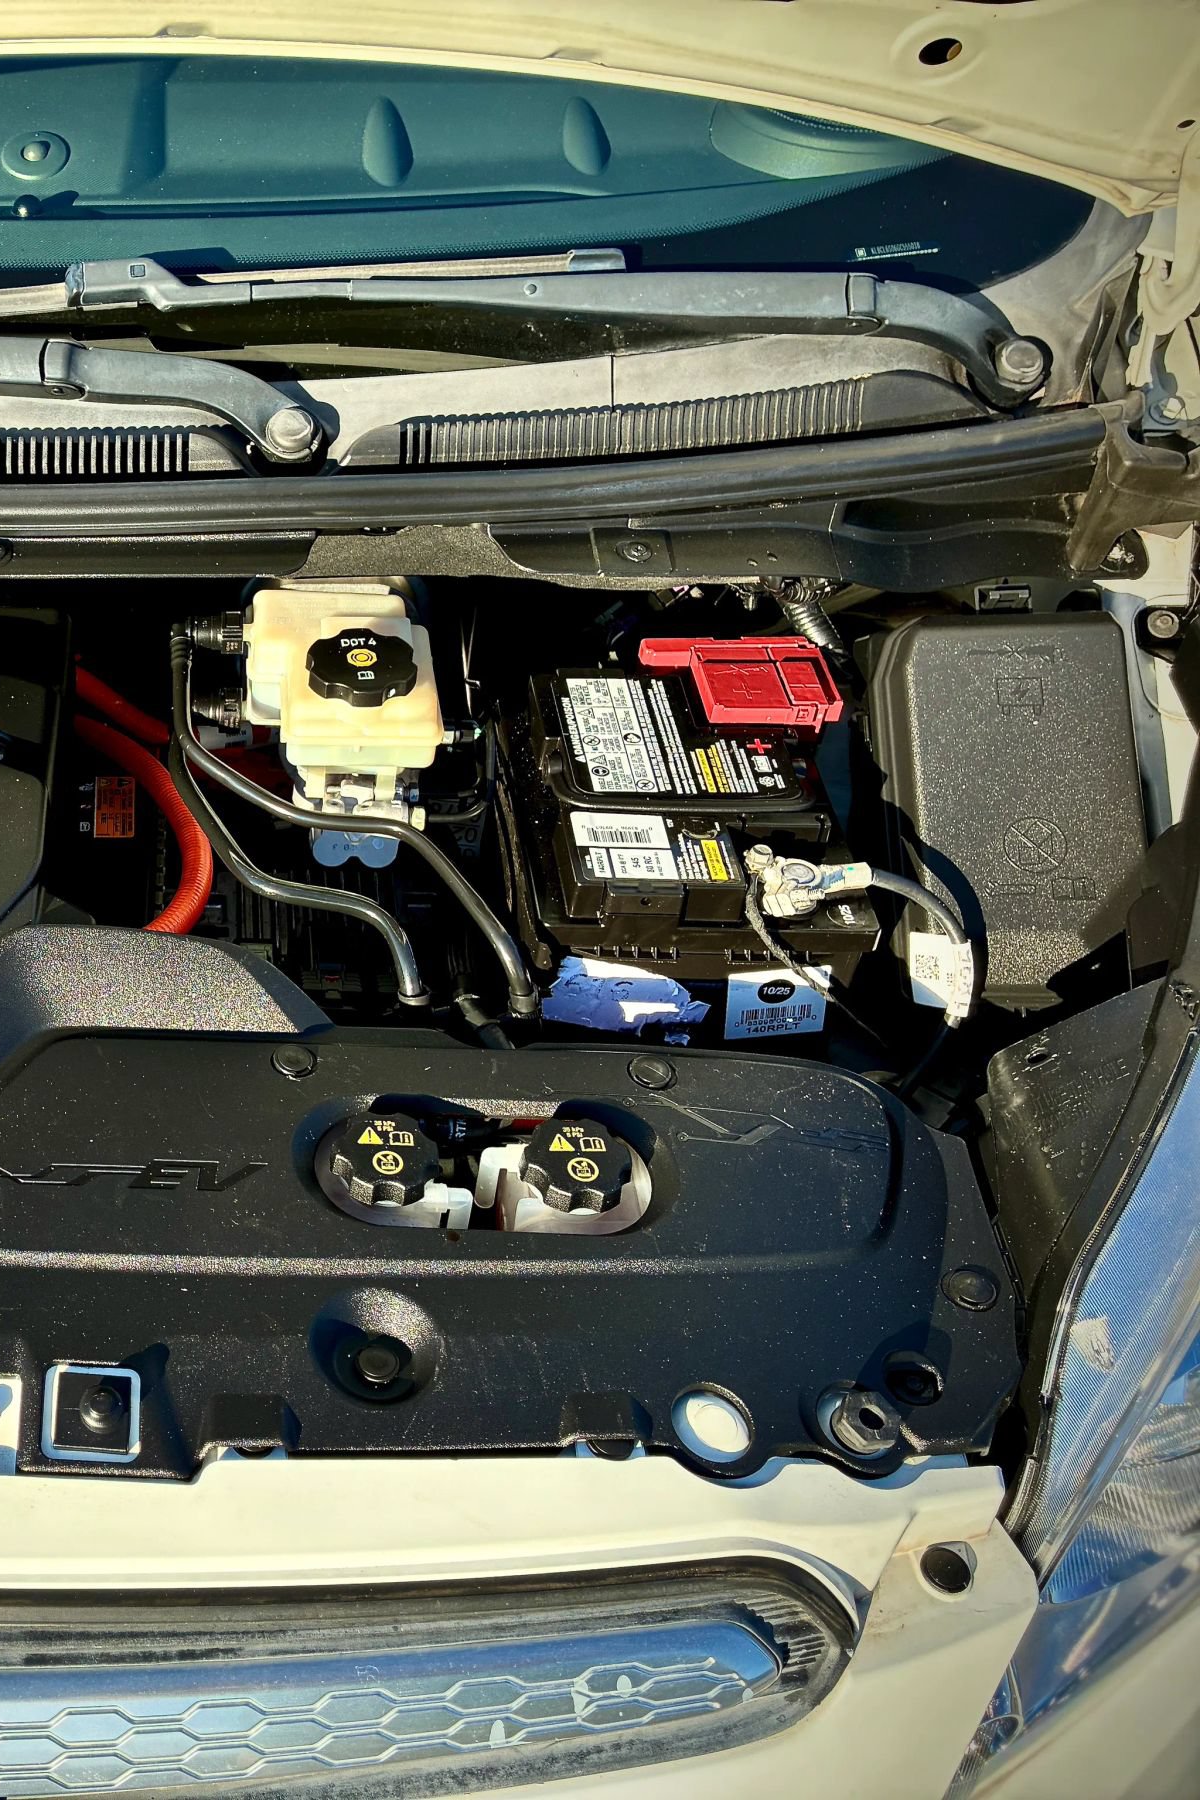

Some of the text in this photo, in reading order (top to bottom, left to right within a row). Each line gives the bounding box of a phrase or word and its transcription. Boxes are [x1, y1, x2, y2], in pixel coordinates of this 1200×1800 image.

[340, 638, 376, 647] DOT 4
[561, 697, 583, 754] DANGER/POISON
[629, 857, 641, 867] 545
[642, 856, 653, 864] RC
[839, 904, 855, 925] 10/25
[762, 986, 791, 995] 10/25
[746, 1023, 801, 1034] 140RPLT
